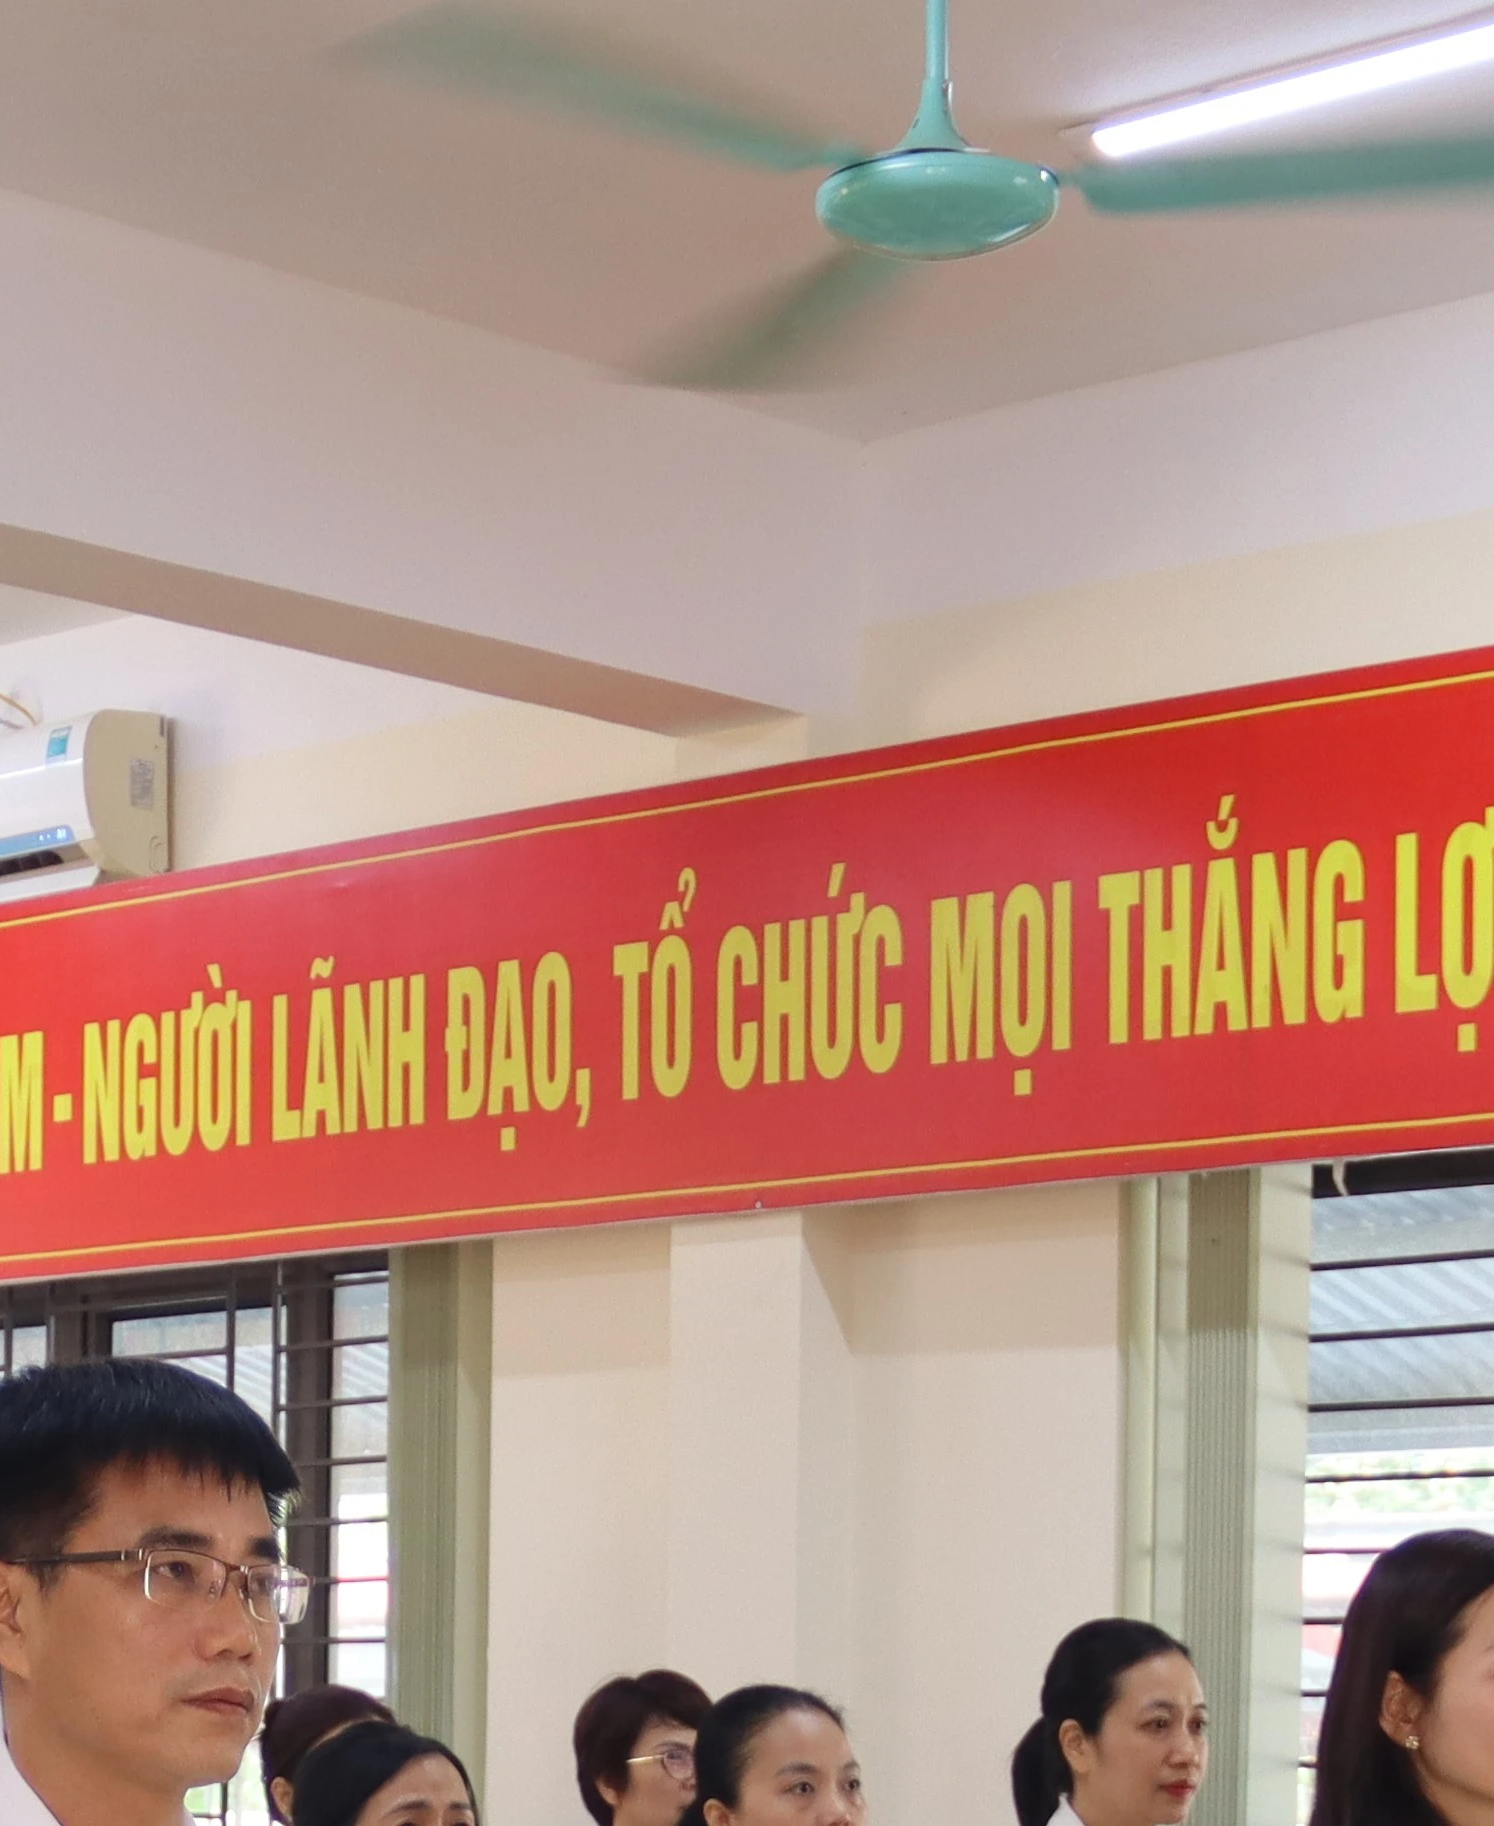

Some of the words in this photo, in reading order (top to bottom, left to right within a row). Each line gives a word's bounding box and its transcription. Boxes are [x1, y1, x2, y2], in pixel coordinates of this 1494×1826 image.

[272, 957, 425, 1142] LÃNH
[444, 951, 591, 1151] ĐẠO,
[613, 867, 696, 1100] TỔ
[717, 863, 903, 1090] CHỨC
[930, 881, 1072, 1096] MỌI
[1098, 795, 1365, 1044] THẮNG
